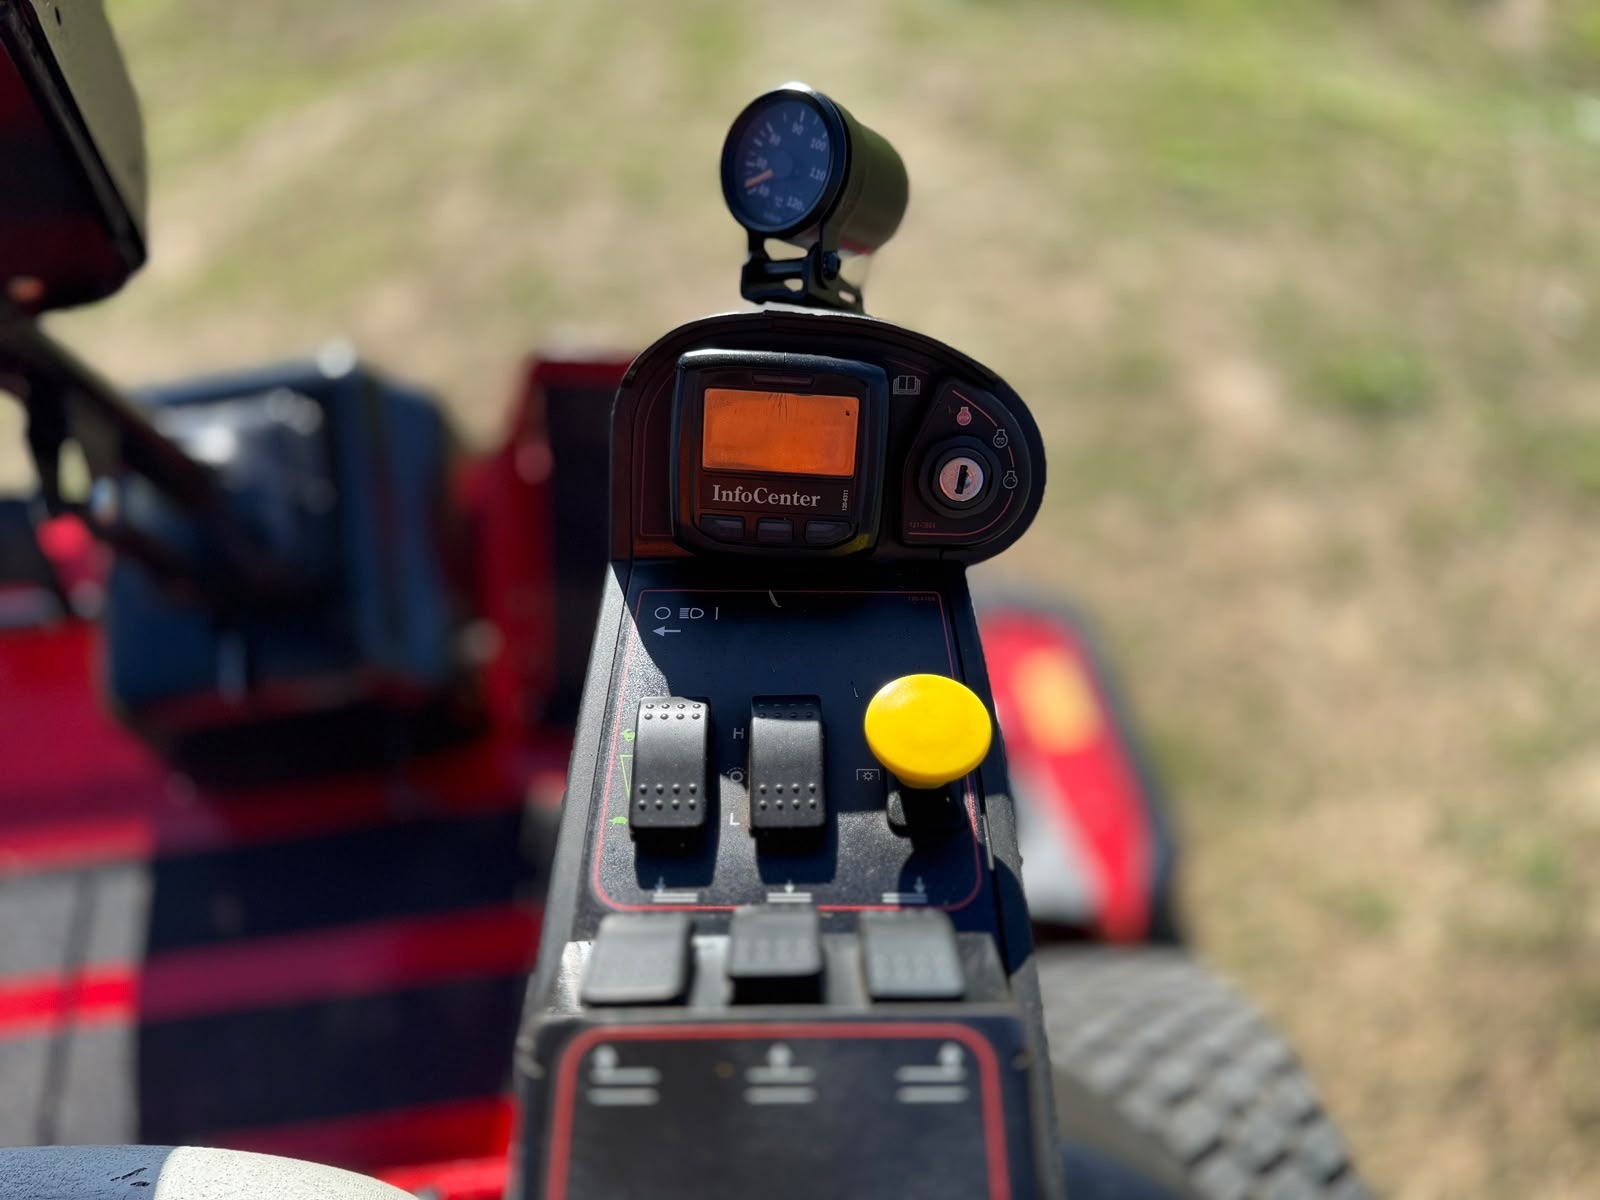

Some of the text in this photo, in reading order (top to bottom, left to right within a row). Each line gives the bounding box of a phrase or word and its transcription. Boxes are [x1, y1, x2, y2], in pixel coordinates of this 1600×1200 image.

[712, 484, 821, 507] InfoCenter
[733, 727, 745, 740] H
[729, 812, 741, 826] L
